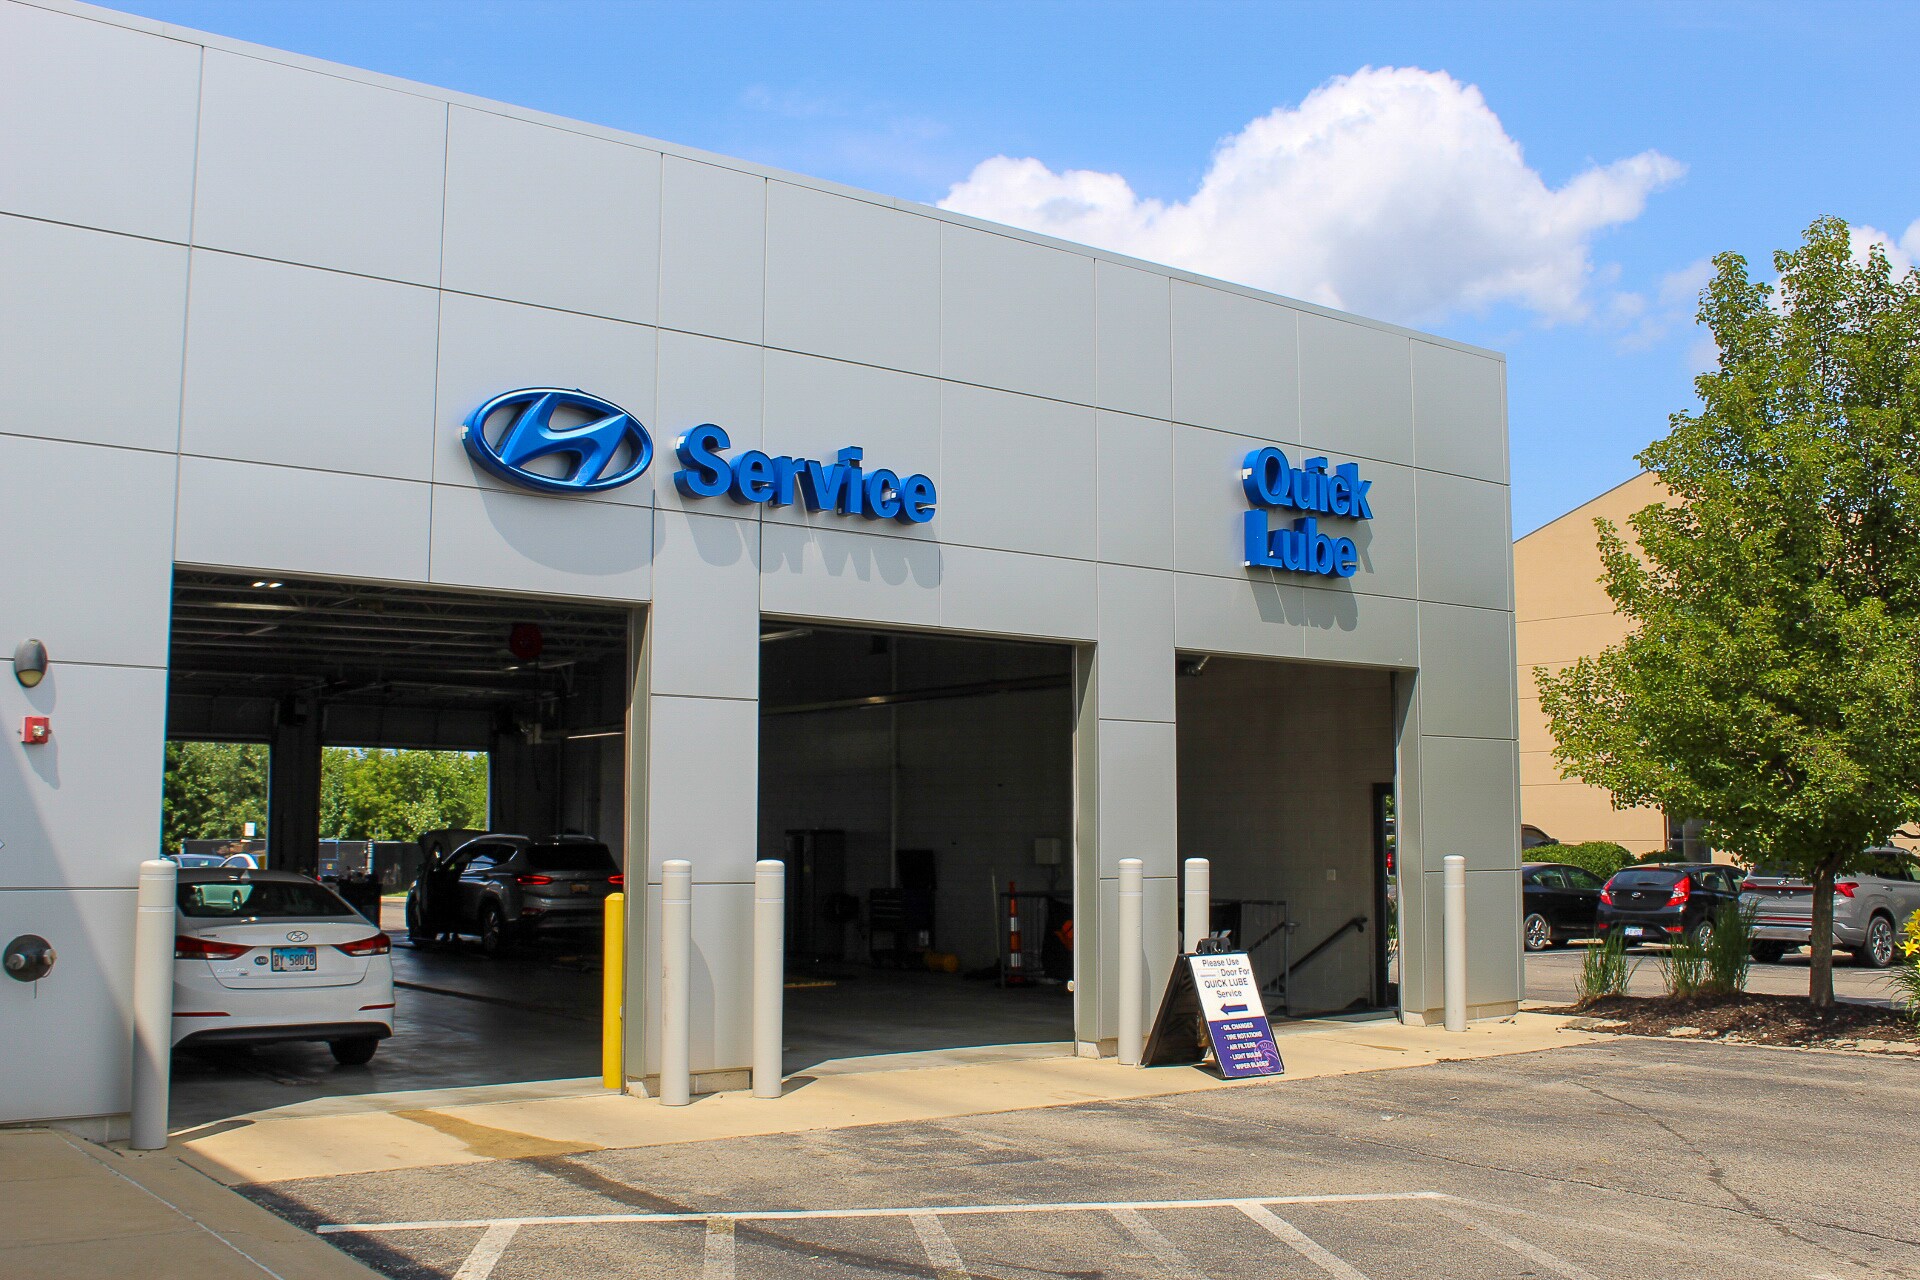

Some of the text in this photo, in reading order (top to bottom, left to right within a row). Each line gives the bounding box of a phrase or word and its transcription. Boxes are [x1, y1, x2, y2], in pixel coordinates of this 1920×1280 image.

[673, 423, 937, 524] Service
[1243, 447, 1373, 519] Quick
[1244, 509, 1357, 578] Lube
[289, 953, 315, 966] 58078
[1202, 958, 1239, 967] Please Use
[1220, 967, 1250, 977] Door For
[1204, 977, 1249, 988] QUICK LUBE
[1216, 990, 1242, 998] Service
[1231, 1022, 1254, 1030] CHANGES
[1237, 1031, 1263, 1039] ROTATIONS
[1232, 1053, 1246, 1061] LIGHT
[1250, 1060, 1269, 1068] BLADES
